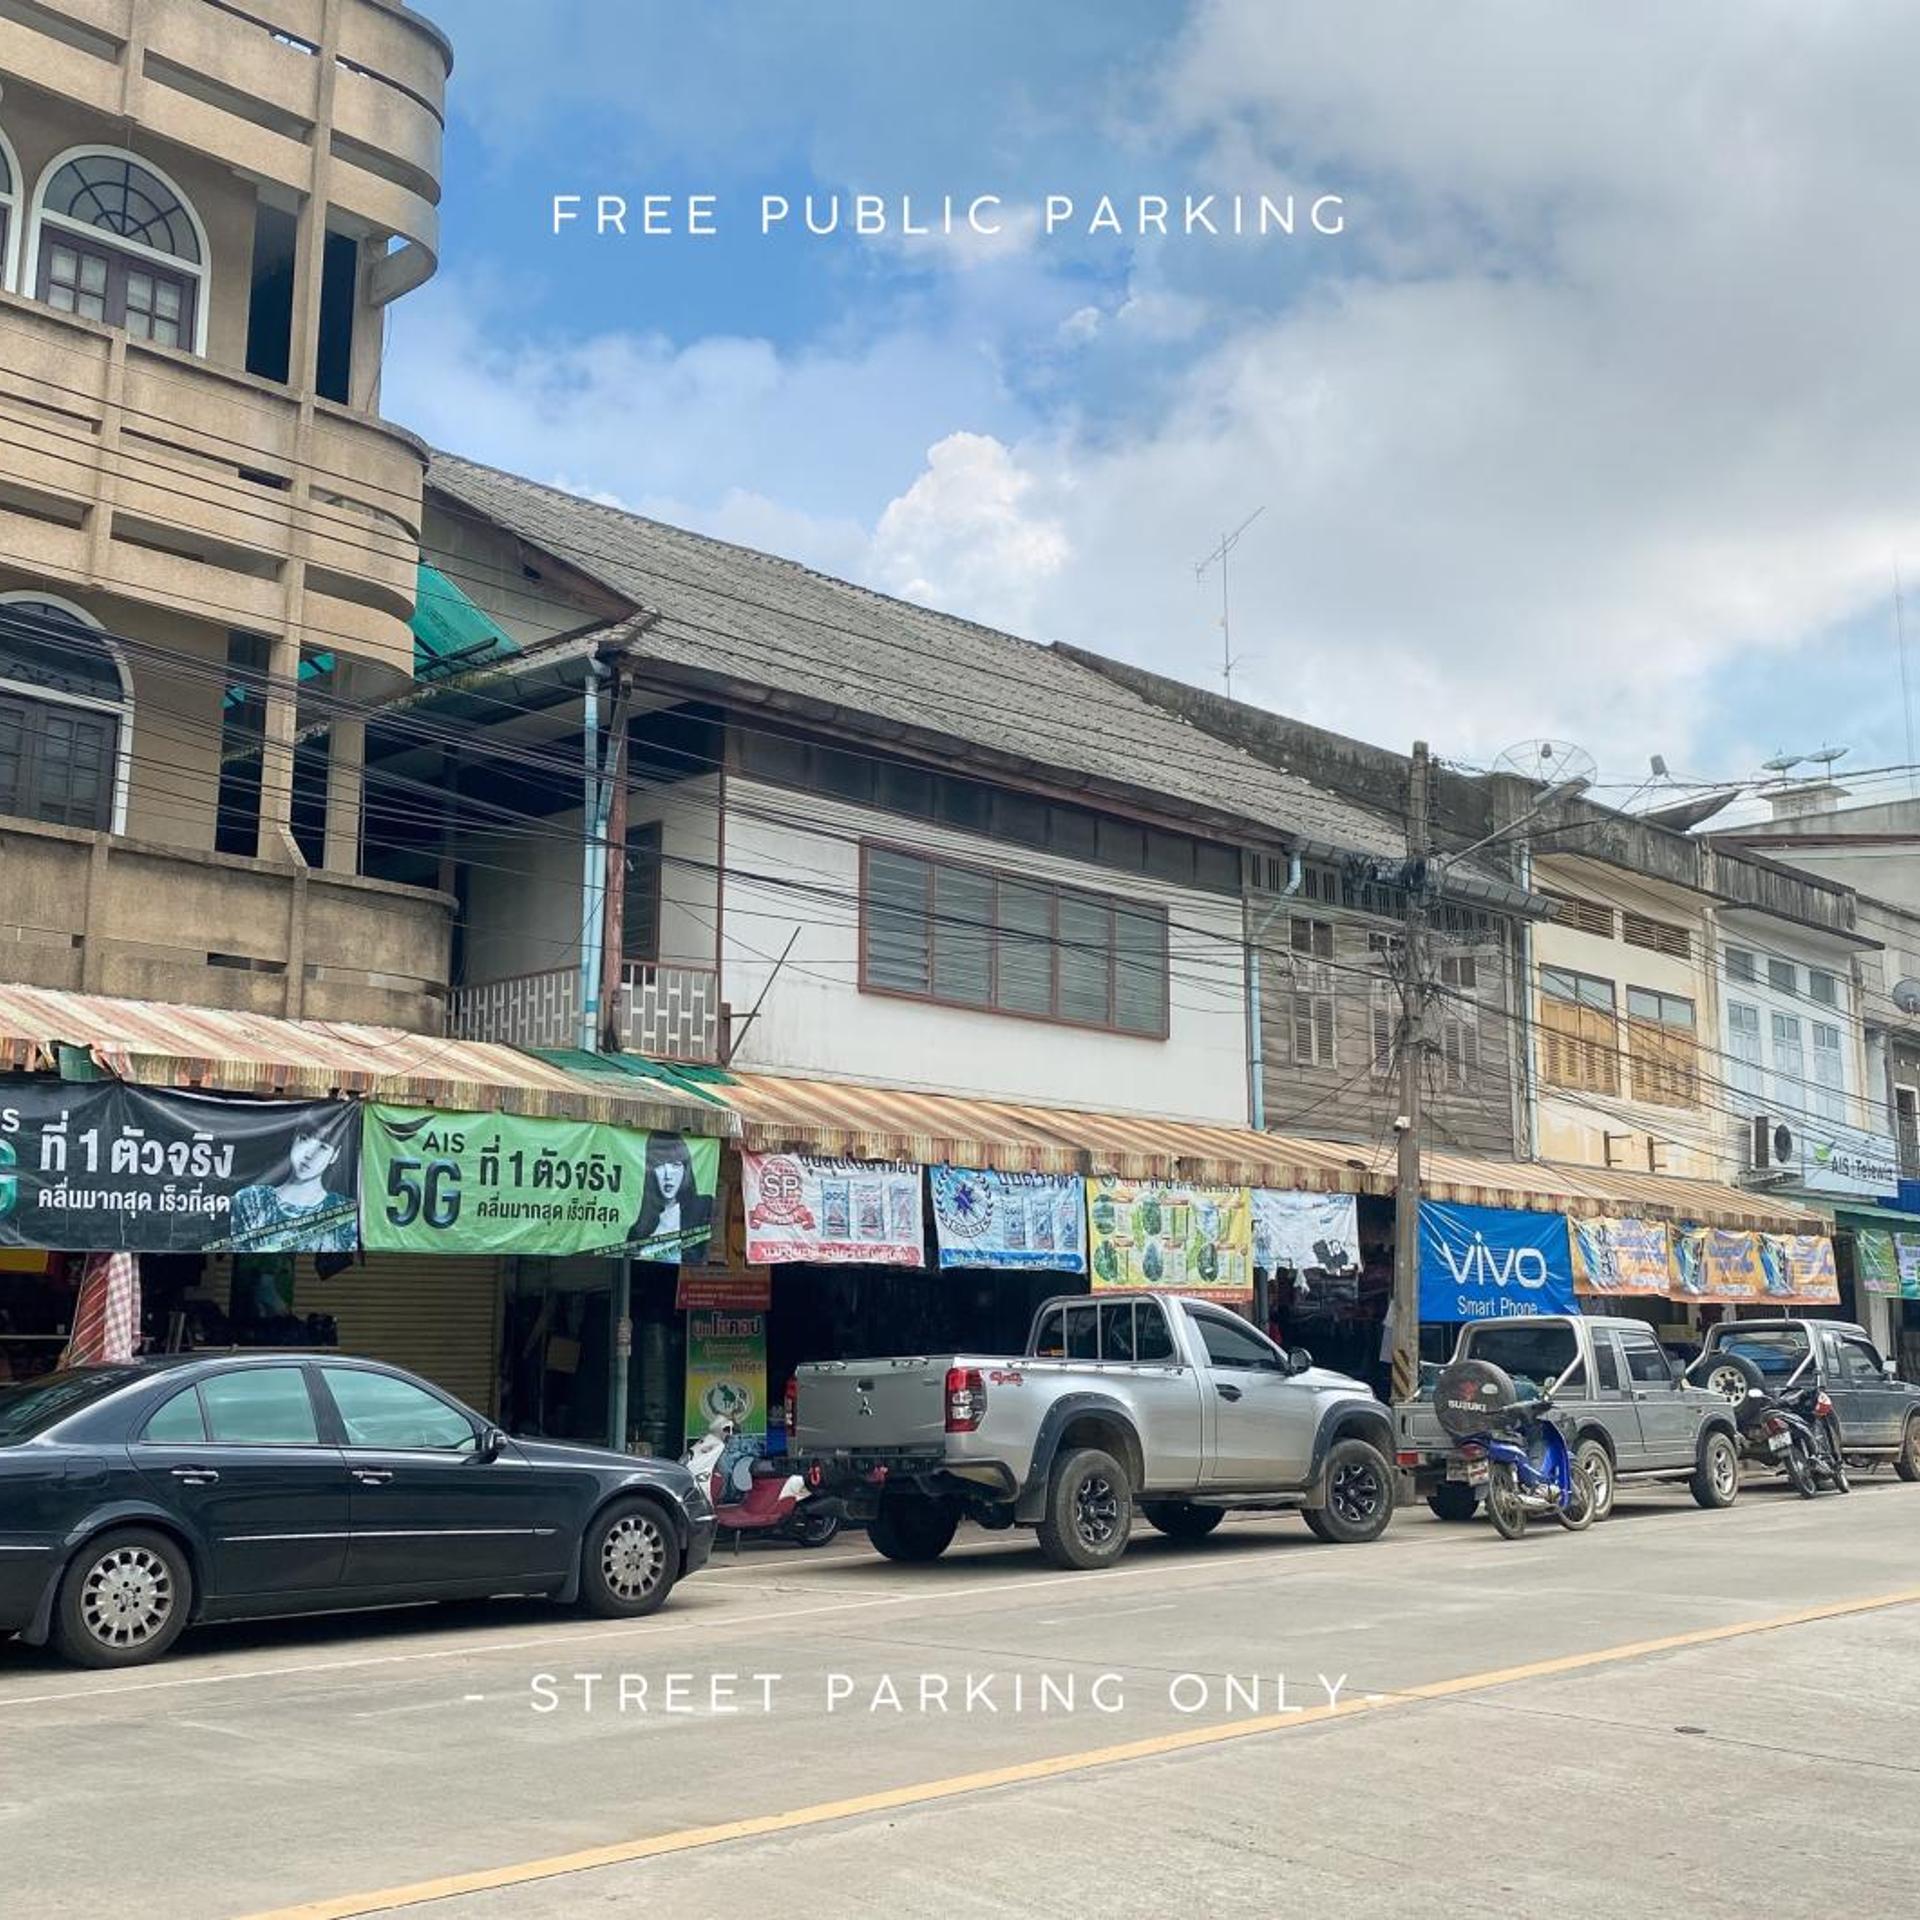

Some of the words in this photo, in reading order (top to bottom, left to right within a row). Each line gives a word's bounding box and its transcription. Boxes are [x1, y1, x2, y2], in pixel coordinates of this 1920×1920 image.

[79, 1129, 98, 1172] 1
[111, 1125, 235, 1179] ตัวจริง
[422, 1131, 465, 1154] AIS
[386, 1157, 462, 1229] 5G
[509, 1151, 523, 1187] 1
[532, 1147, 623, 1193] ตัวจริง
[1443, 1231, 1547, 1288] vivo
[1457, 1295, 1496, 1316] Smart
[1500, 1297, 1538, 1316] Phone
